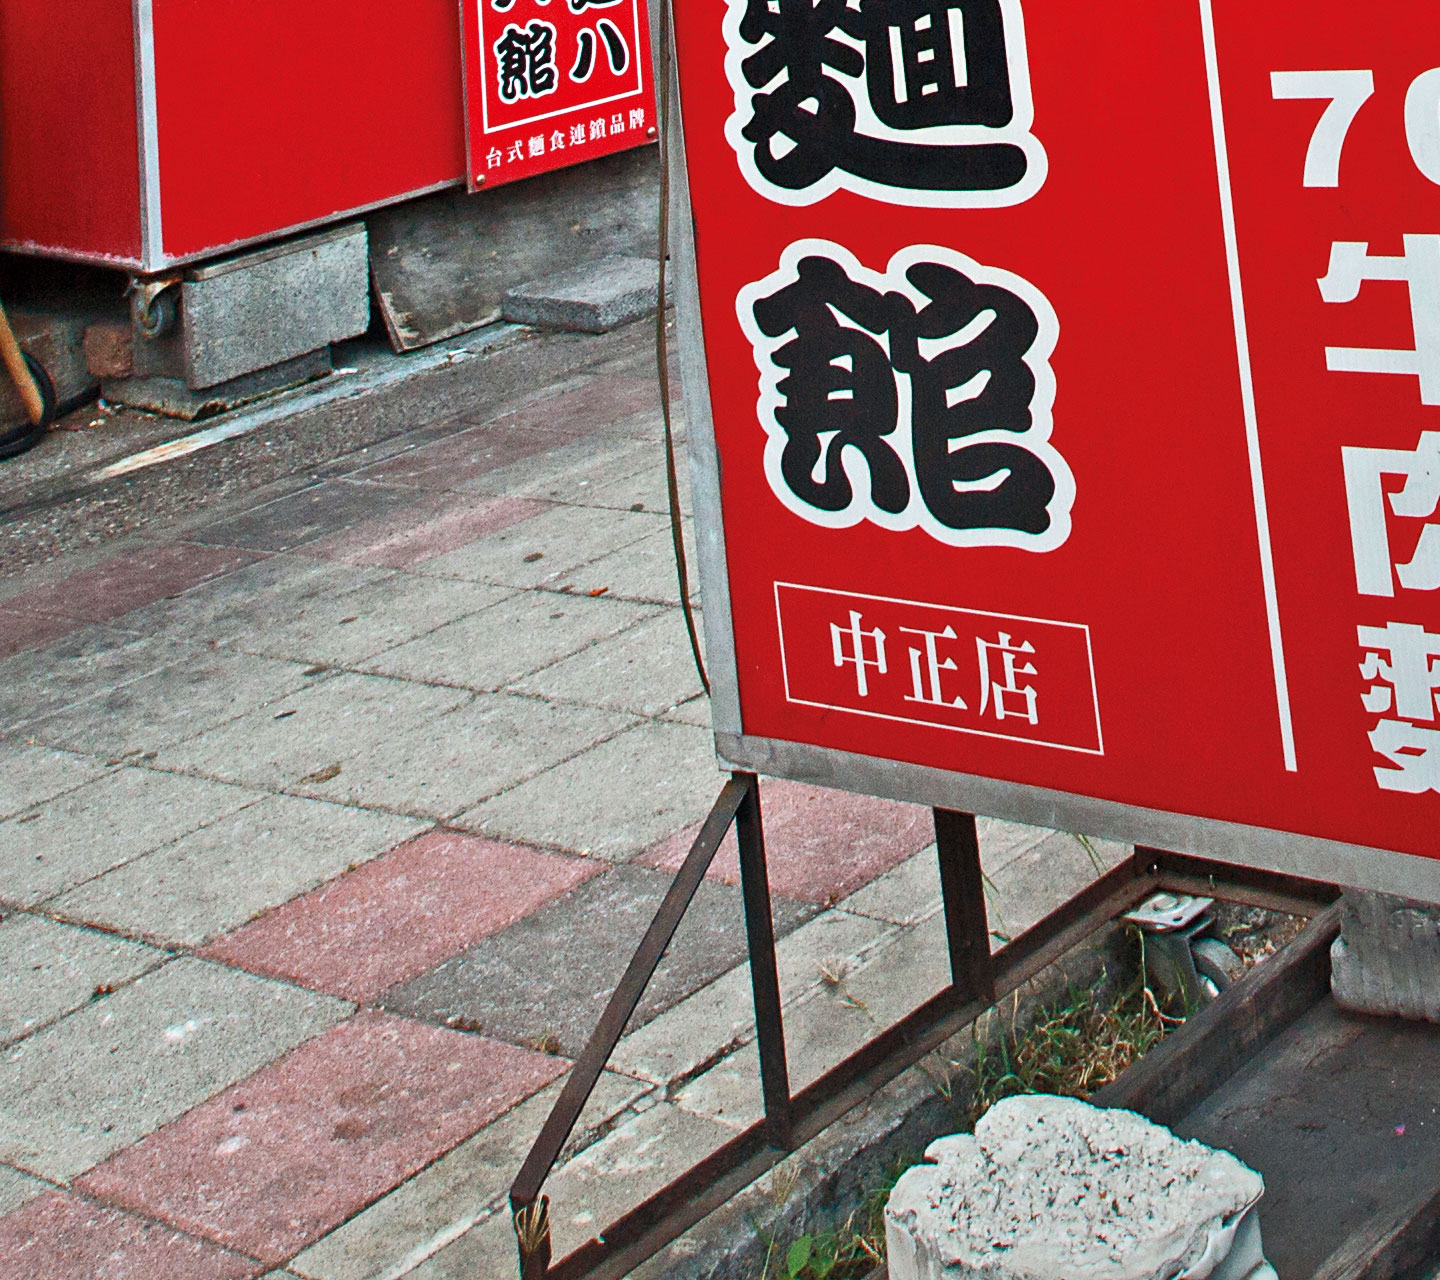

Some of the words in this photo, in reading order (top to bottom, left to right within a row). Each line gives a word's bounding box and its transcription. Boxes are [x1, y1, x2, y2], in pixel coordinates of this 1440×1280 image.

[484, 107, 647, 171] 台式麵食連鎖品牌
[828, 608, 1040, 727] 中正店
